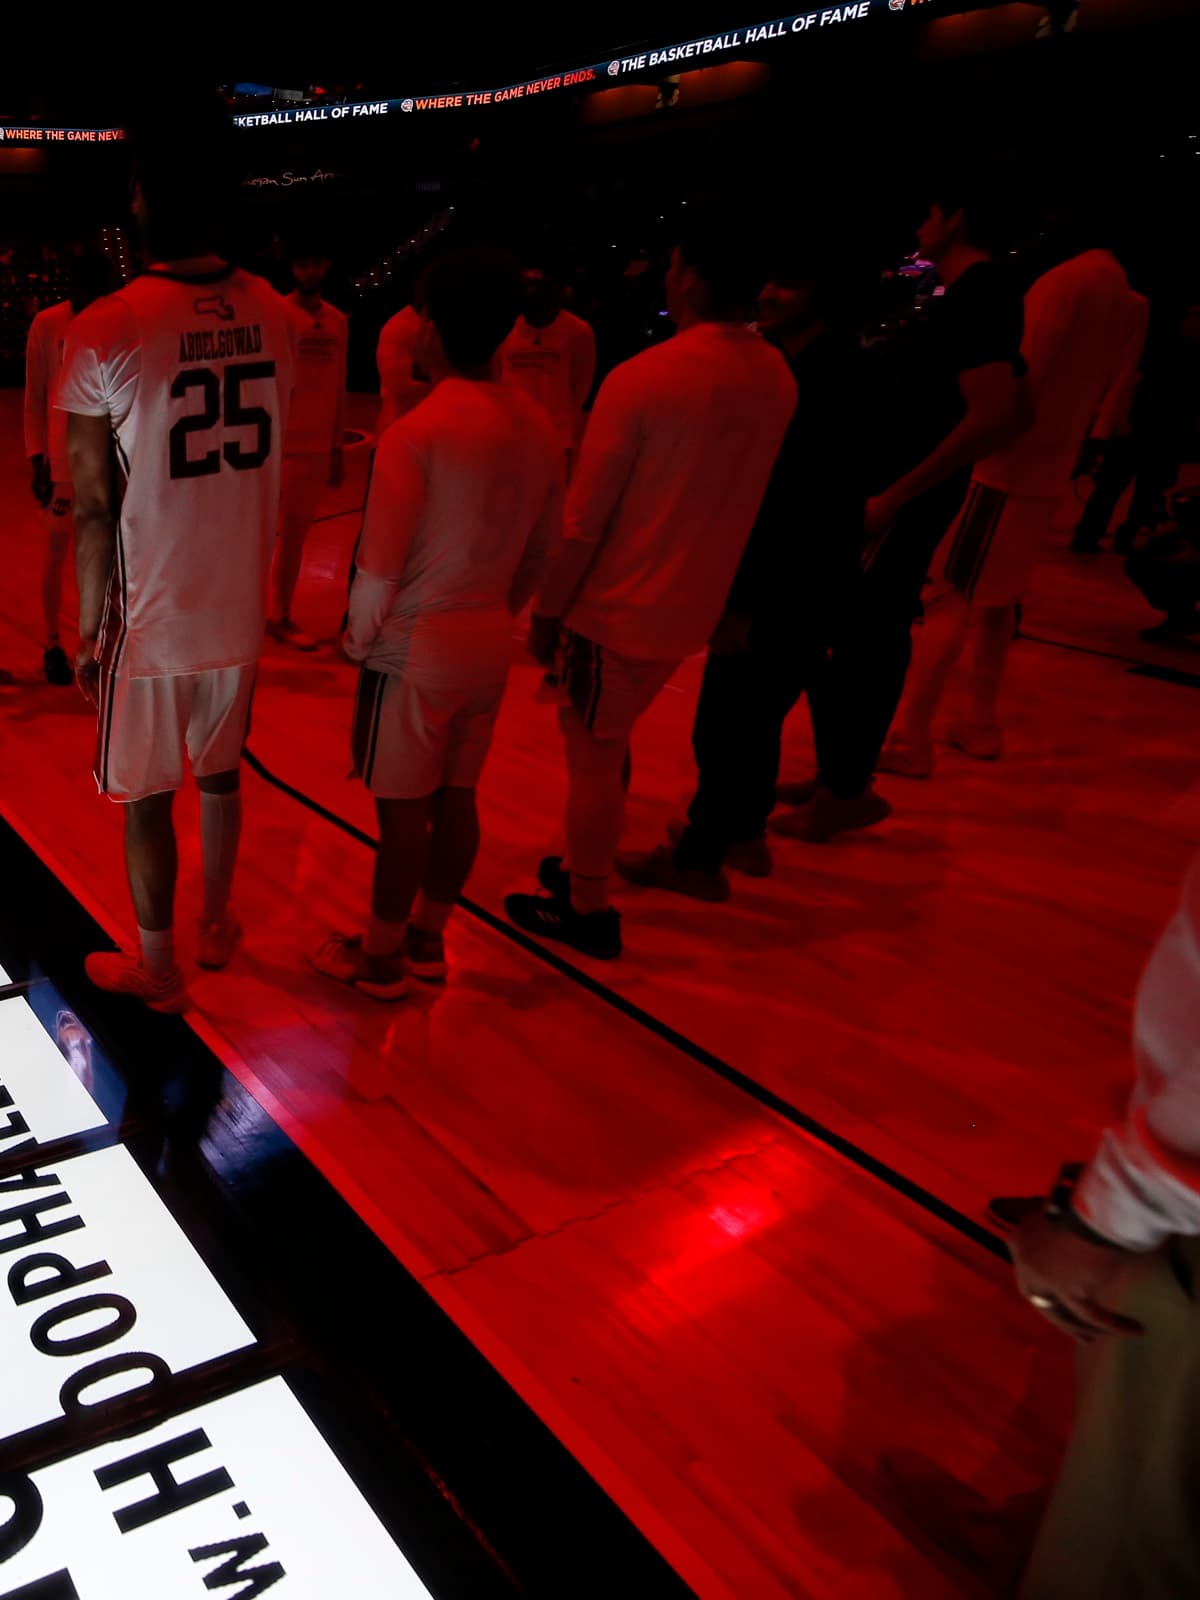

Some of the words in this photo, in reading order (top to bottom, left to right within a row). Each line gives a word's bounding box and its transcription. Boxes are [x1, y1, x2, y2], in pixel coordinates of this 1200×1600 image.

[621, 54, 647, 73] THE
[649, 32, 741, 66] BASKETBALL
[744, 21, 787, 44] HALL
[791, 14, 818, 33] OF
[820, 1, 871, 27] FAME
[416, 95, 462, 110] WHERE
[465, 92, 492, 106] THE
[494, 86, 525, 103] GAME
[526, 76, 561, 97] NEVER
[563, 69, 596, 87] ENDS.
[295, 107, 329, 123] HALL
[331, 106, 350, 119] OF
[352, 102, 389, 117] FAME
[5, 128, 43, 140] WHERE
[45, 130, 65, 141] THE
[67, 131, 96, 142] GAME
[98, 130, 127, 142] NEVE
[280, 172, 308, 187] Sun
[179, 324, 262, 363] ABDELGOWAD
[169, 360, 276, 480] 25
